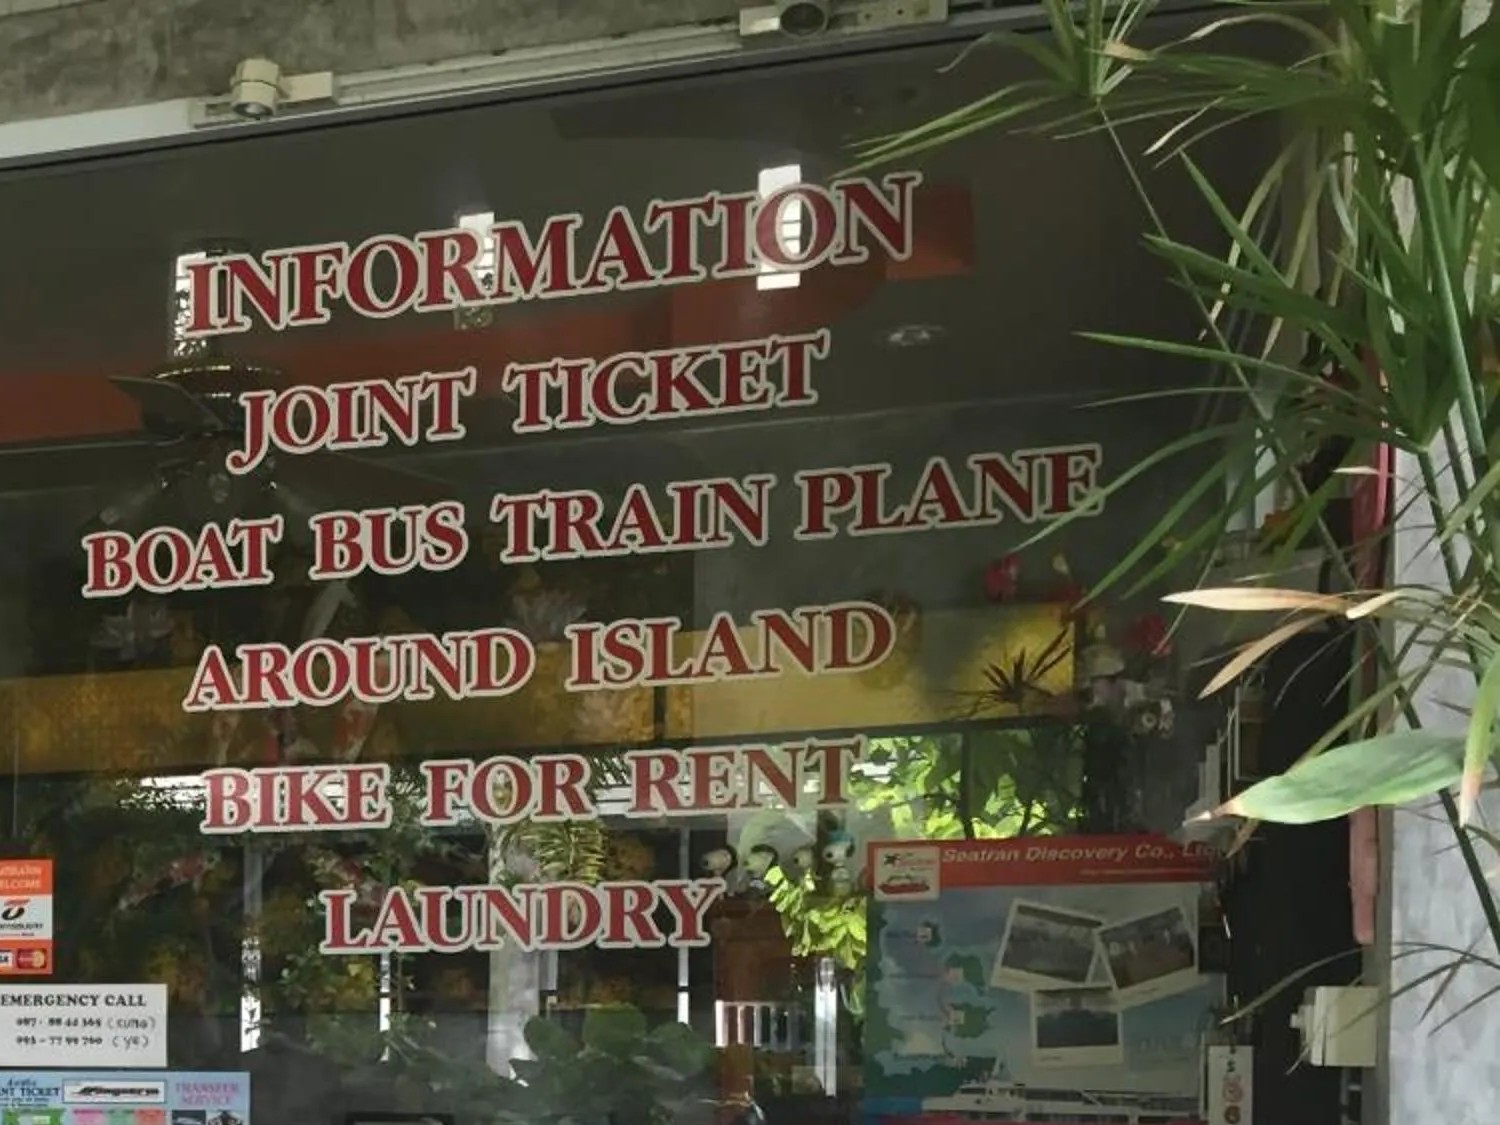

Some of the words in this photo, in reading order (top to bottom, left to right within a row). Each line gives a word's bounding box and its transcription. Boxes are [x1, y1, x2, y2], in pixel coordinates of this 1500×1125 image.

[184, 172, 923, 338] INFORMATION
[228, 366, 476, 472] JOINT
[501, 330, 831, 432] TICKET
[81, 516, 283, 597] BOAT
[310, 501, 469, 580] BUS
[492, 474, 777, 561] TRAIN
[795, 444, 1104, 541] PLANE
[183, 629, 536, 711] AROUND
[565, 600, 900, 693] ISLAND
[199, 761, 392, 835] BIKE
[420, 750, 600, 828] FOR
[630, 735, 866, 818] RENT
[1025, 844, 1127, 862] Discovery
[318, 878, 727, 955] LAUNDRY
[1, 994, 100, 1006] EMERGENCY
[104, 994, 147, 1006] CALL
